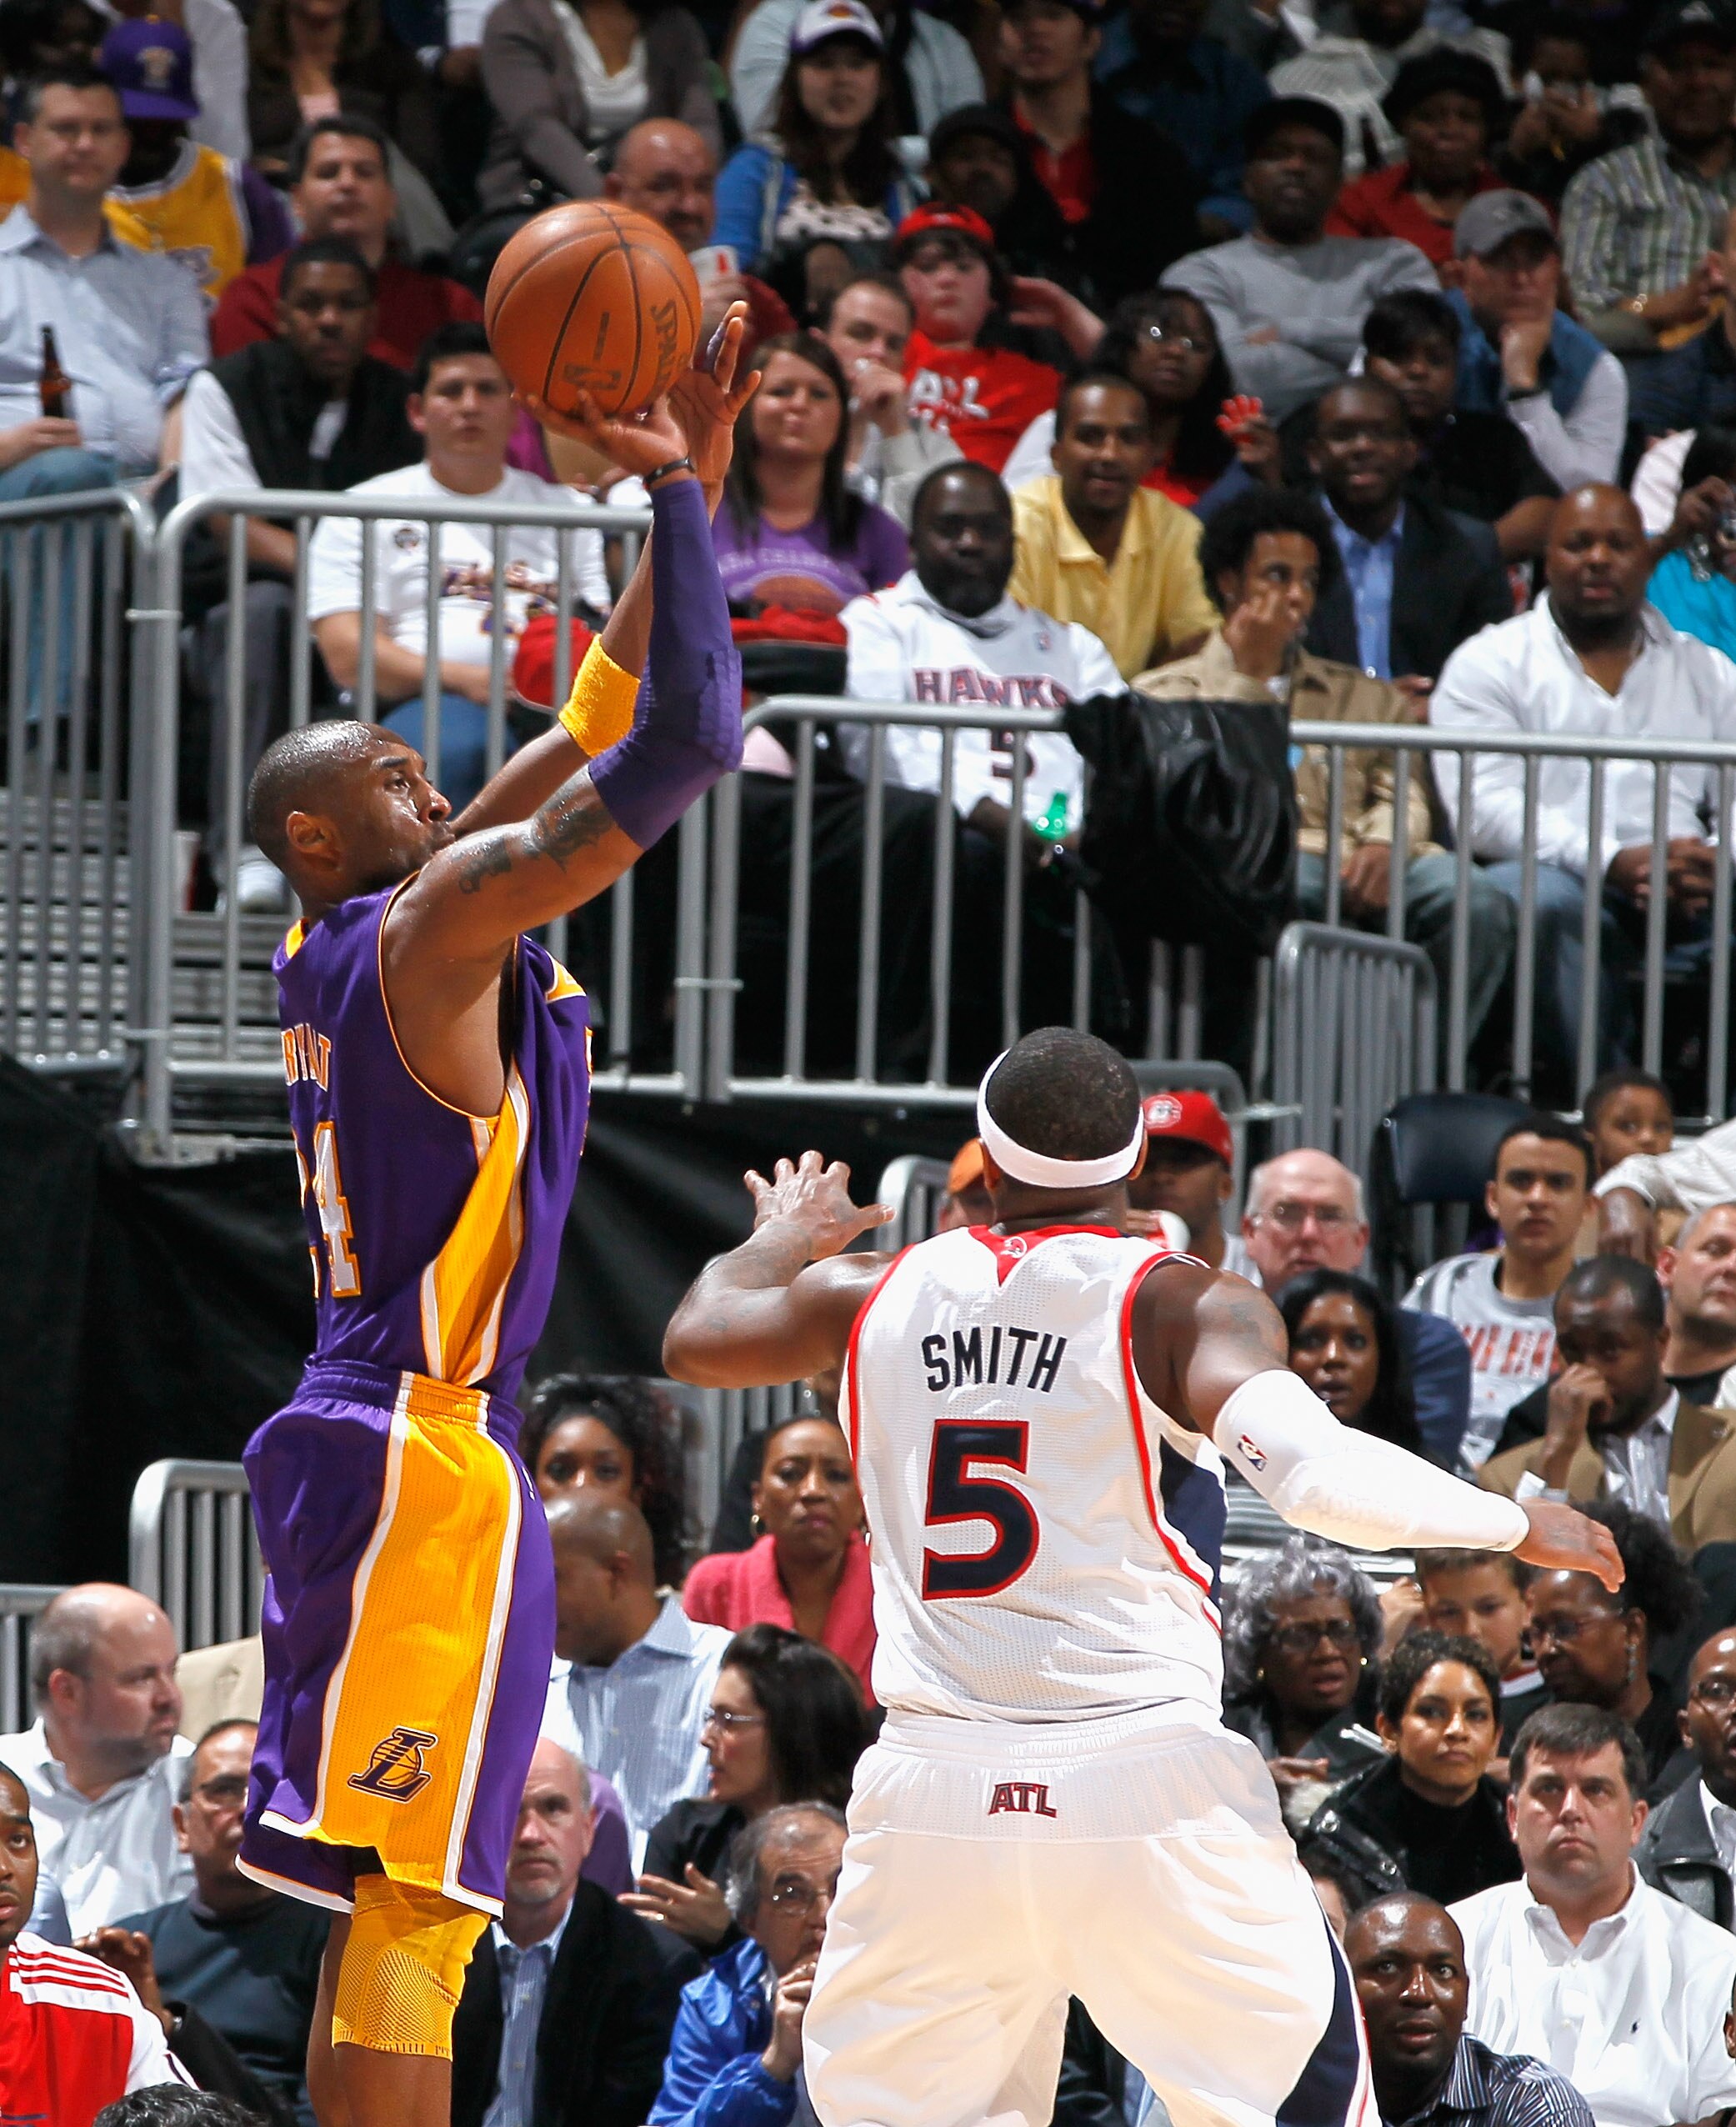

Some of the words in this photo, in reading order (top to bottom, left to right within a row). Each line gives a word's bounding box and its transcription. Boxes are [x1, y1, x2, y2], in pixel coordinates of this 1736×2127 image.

[292, 1120, 362, 1298] 4
[921, 1325, 1068, 1394] SMITH
[922, 1419, 1041, 1601] 5
[988, 1782, 1057, 1818] ATL
